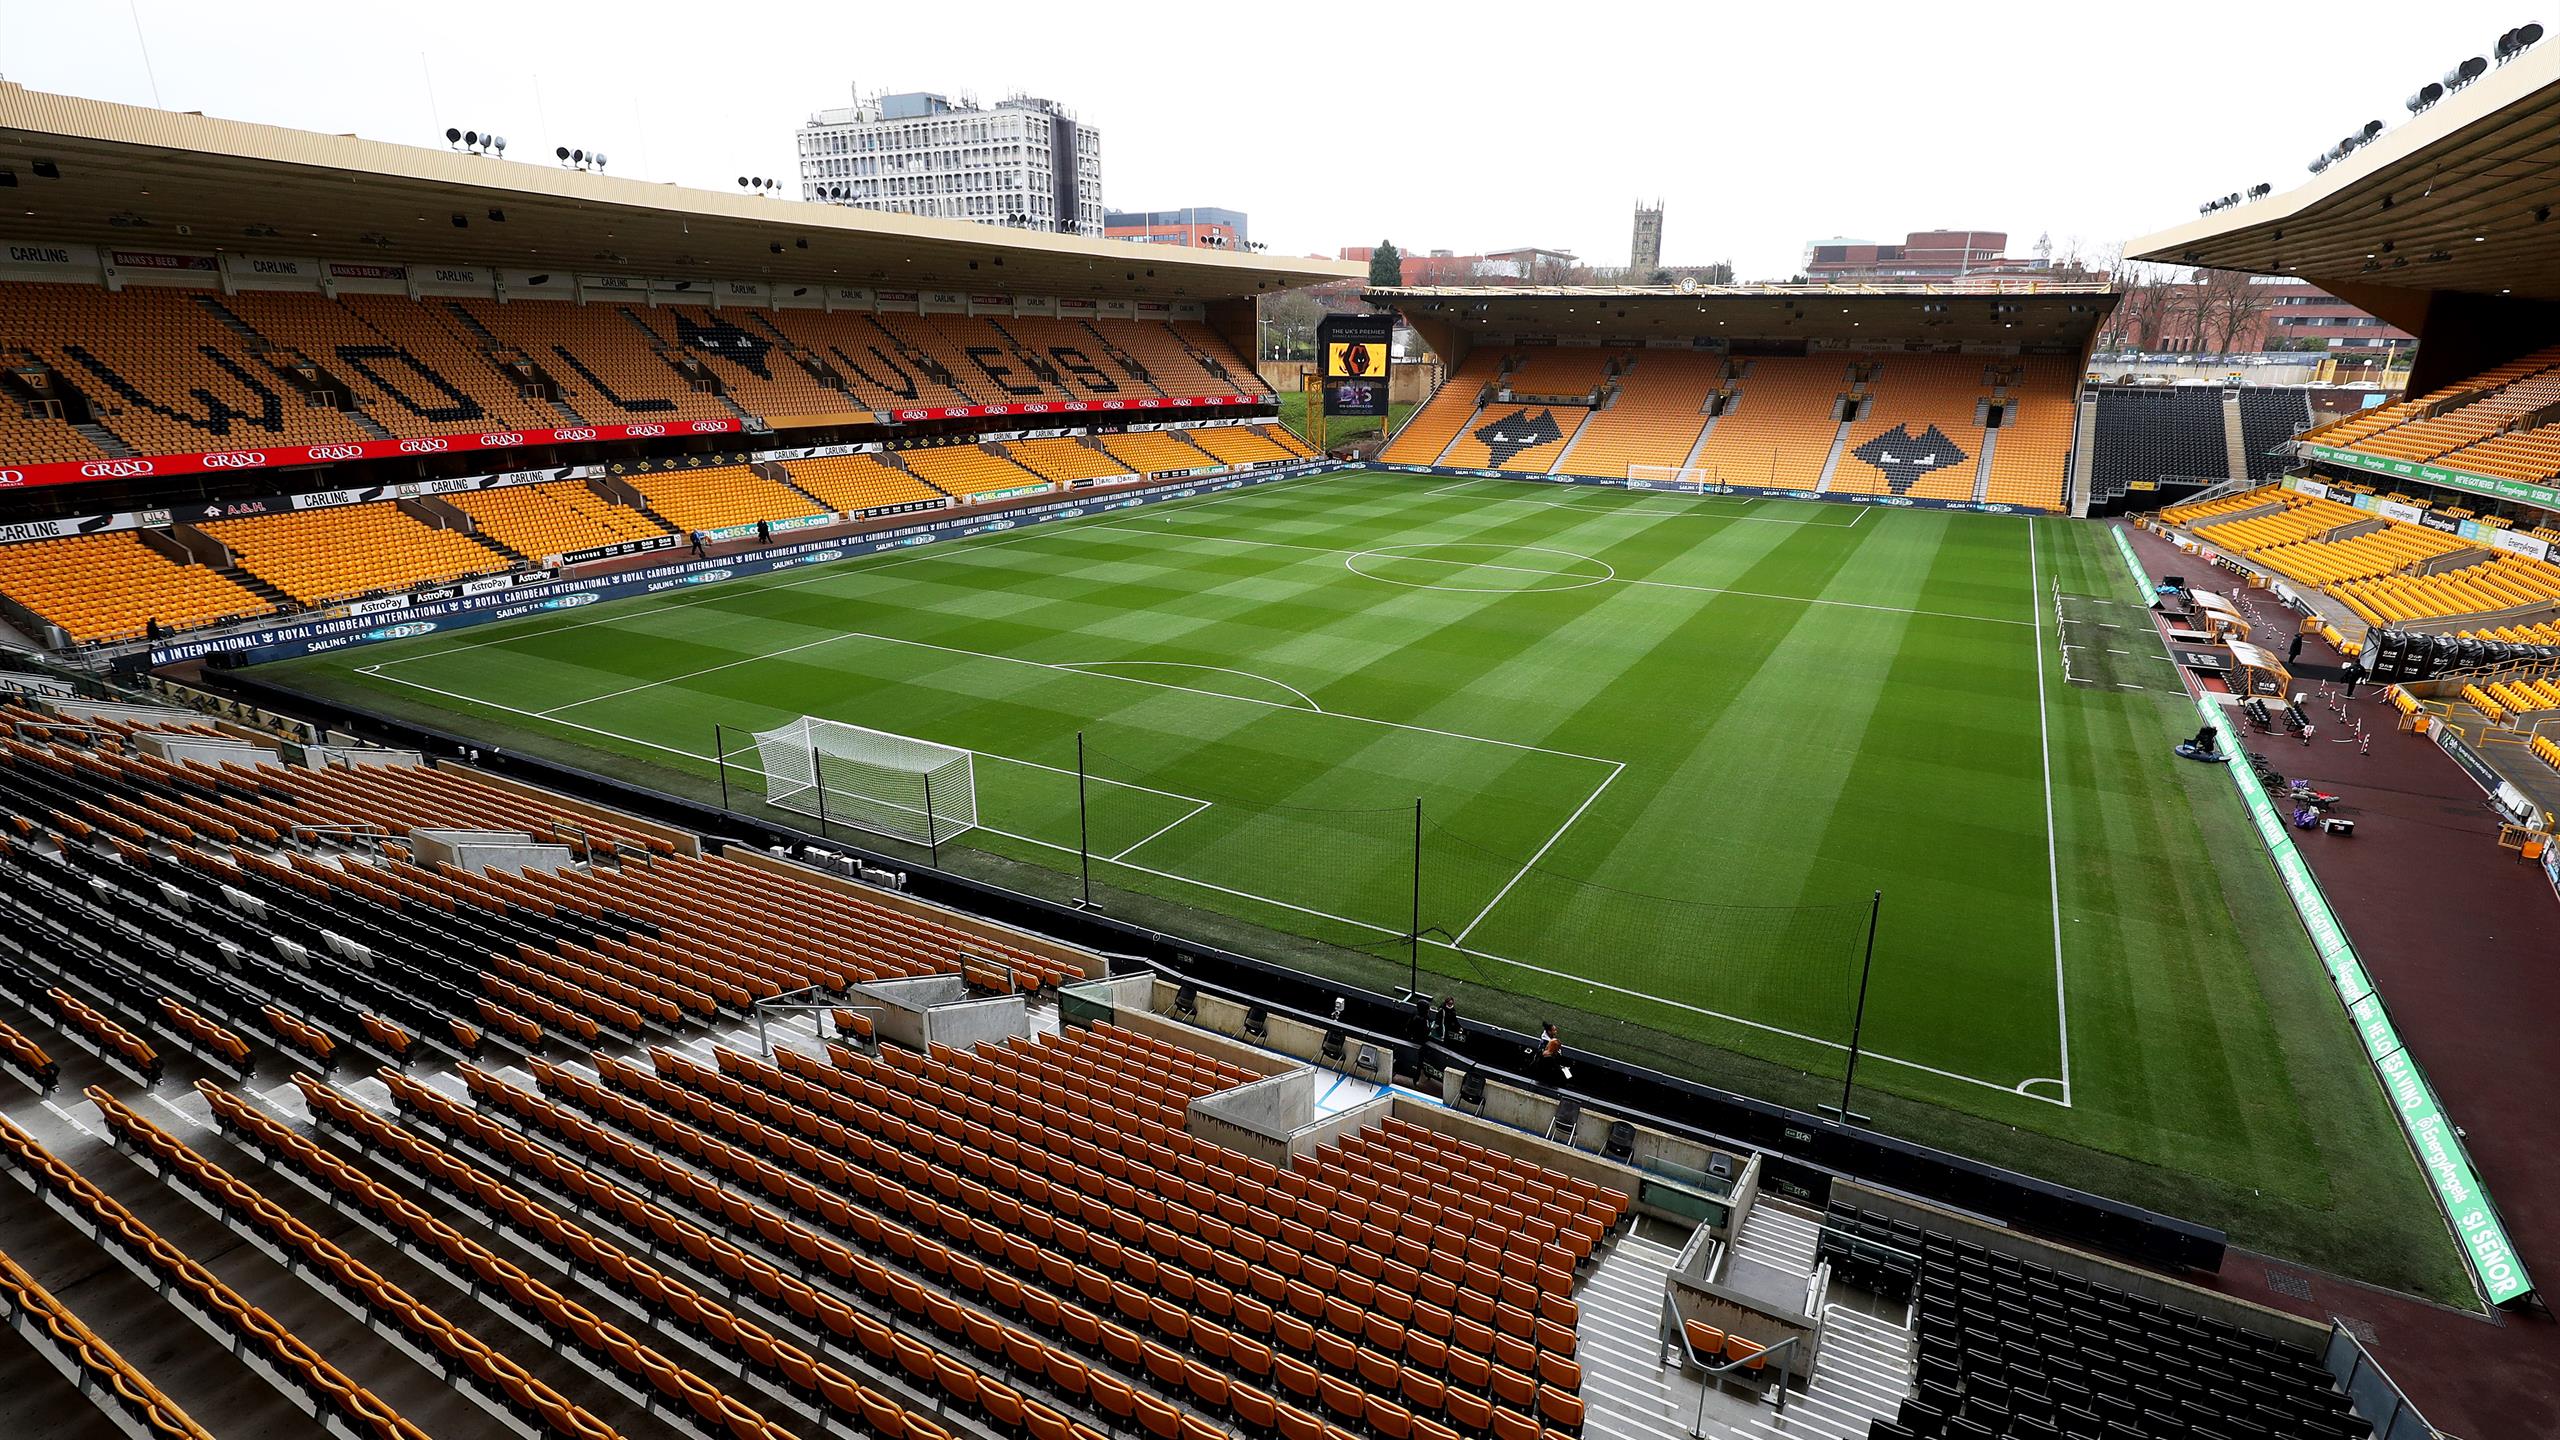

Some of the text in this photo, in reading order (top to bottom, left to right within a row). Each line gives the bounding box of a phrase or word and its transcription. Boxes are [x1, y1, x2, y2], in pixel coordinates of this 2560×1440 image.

[11, 246, 70, 263] CARLING
[155, 257, 178, 267] BEER
[253, 260, 297, 274] CARLING
[436, 270, 474, 283] CARLING
[601, 277, 629, 288] CARLING
[730, 283, 757, 294] CARLING
[945, 408, 969, 417] GRAND
[985, 405, 1008, 414] GRAND
[1024, 404, 1048, 412] GRAND
[1065, 402, 1088, 411] GRAND
[902, 411, 928, 419] GRAND
[626, 425, 665, 436] GRAND
[692, 421, 728, 432] GRAND
[480, 433, 524, 446] GRAND
[554, 429, 597, 440] GRAND
[308, 445, 363, 459] GRAND
[400, 439, 448, 452] GRAND
[825, 446, 848, 455] CARLING
[203, 452, 266, 467] GRAND
[774, 450, 799, 460] CARLING
[81, 460, 153, 477] GRAND
[510, 471, 544, 484] CARLING
[431, 479, 468, 493] CARLING
[1012, 485, 1047, 497] bet365.com
[304, 491, 349, 507] CARLING
[710, 516, 829, 540] bet365.co bet365.com
[745, 539, 840, 562] ROYAL CARIBBEAN INTERNATIONAL
[622, 556, 734, 583] ROYAL CARIBBEAN INTERNATIONAL
[772, 559, 794, 570] SAILING
[518, 569, 551, 583] AstroPay
[471, 578, 507, 592] AstroPay
[476, 576, 610, 607] ROYAL CARIBBEAN INTERNATIONAL
[648, 579, 674, 592] SAILING
[417, 588, 454, 602] AstroPay
[361, 598, 402, 613] AstroPay
[497, 605, 528, 618] SAILING
[278, 603, 447, 641] ROYAL CARIBBEAN INTERNATIONAL
[170, 635, 259, 661] INTERNATIONAL
[307, 637, 347, 652] SAILING
[2367, 1021, 2386, 1039] HE
[2391, 1069, 2408, 1080] A
[2422, 1127, 2471, 1204] EnergyAngels
[2462, 1211, 2487, 1232] SI
